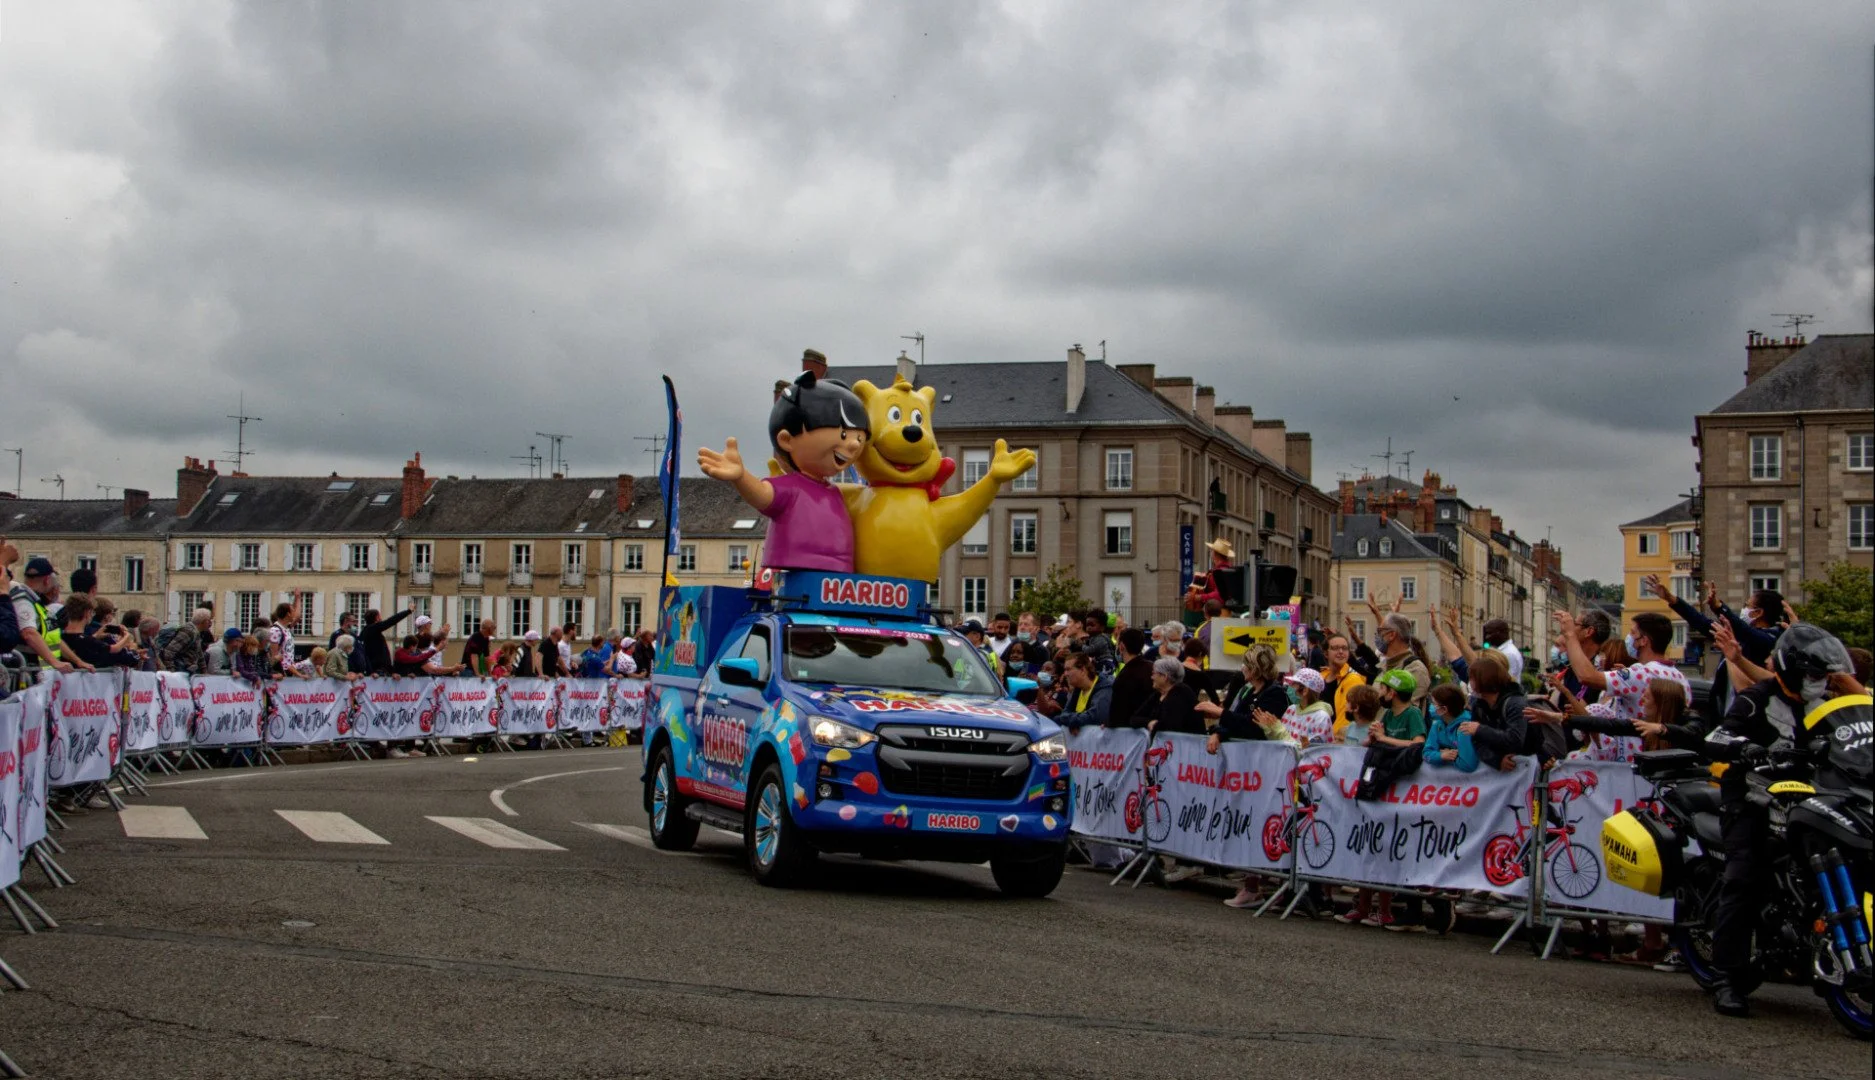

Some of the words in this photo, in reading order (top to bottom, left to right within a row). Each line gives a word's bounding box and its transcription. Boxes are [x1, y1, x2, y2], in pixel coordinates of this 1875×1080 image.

[821, 577, 910, 609] HARIBO
[673, 640, 697, 668] HARIBO
[284, 693, 308, 704] LAVAL
[309, 692, 335, 703] AGGLO
[371, 692, 391, 702] LAVAL
[390, 691, 419, 702] AGGLO
[850, 699, 1028, 722] HARIBO
[703, 714, 746, 766] HARIBO
[930, 727, 984, 739] ISUZU
[1068, 751, 1090, 770] VAL
[1090, 752, 1124, 772] AGGLO
[1178, 762, 1216, 789] LAVAL
[1780, 782, 1811, 790] YAMAHA
[1339, 777, 1400, 803] LAL
[1402, 784, 1480, 808] AGGLO
[928, 813, 981, 830] HARIBO
[1806, 797, 1854, 826] NIKEN
[1604, 834, 1638, 866] YAMAHA
